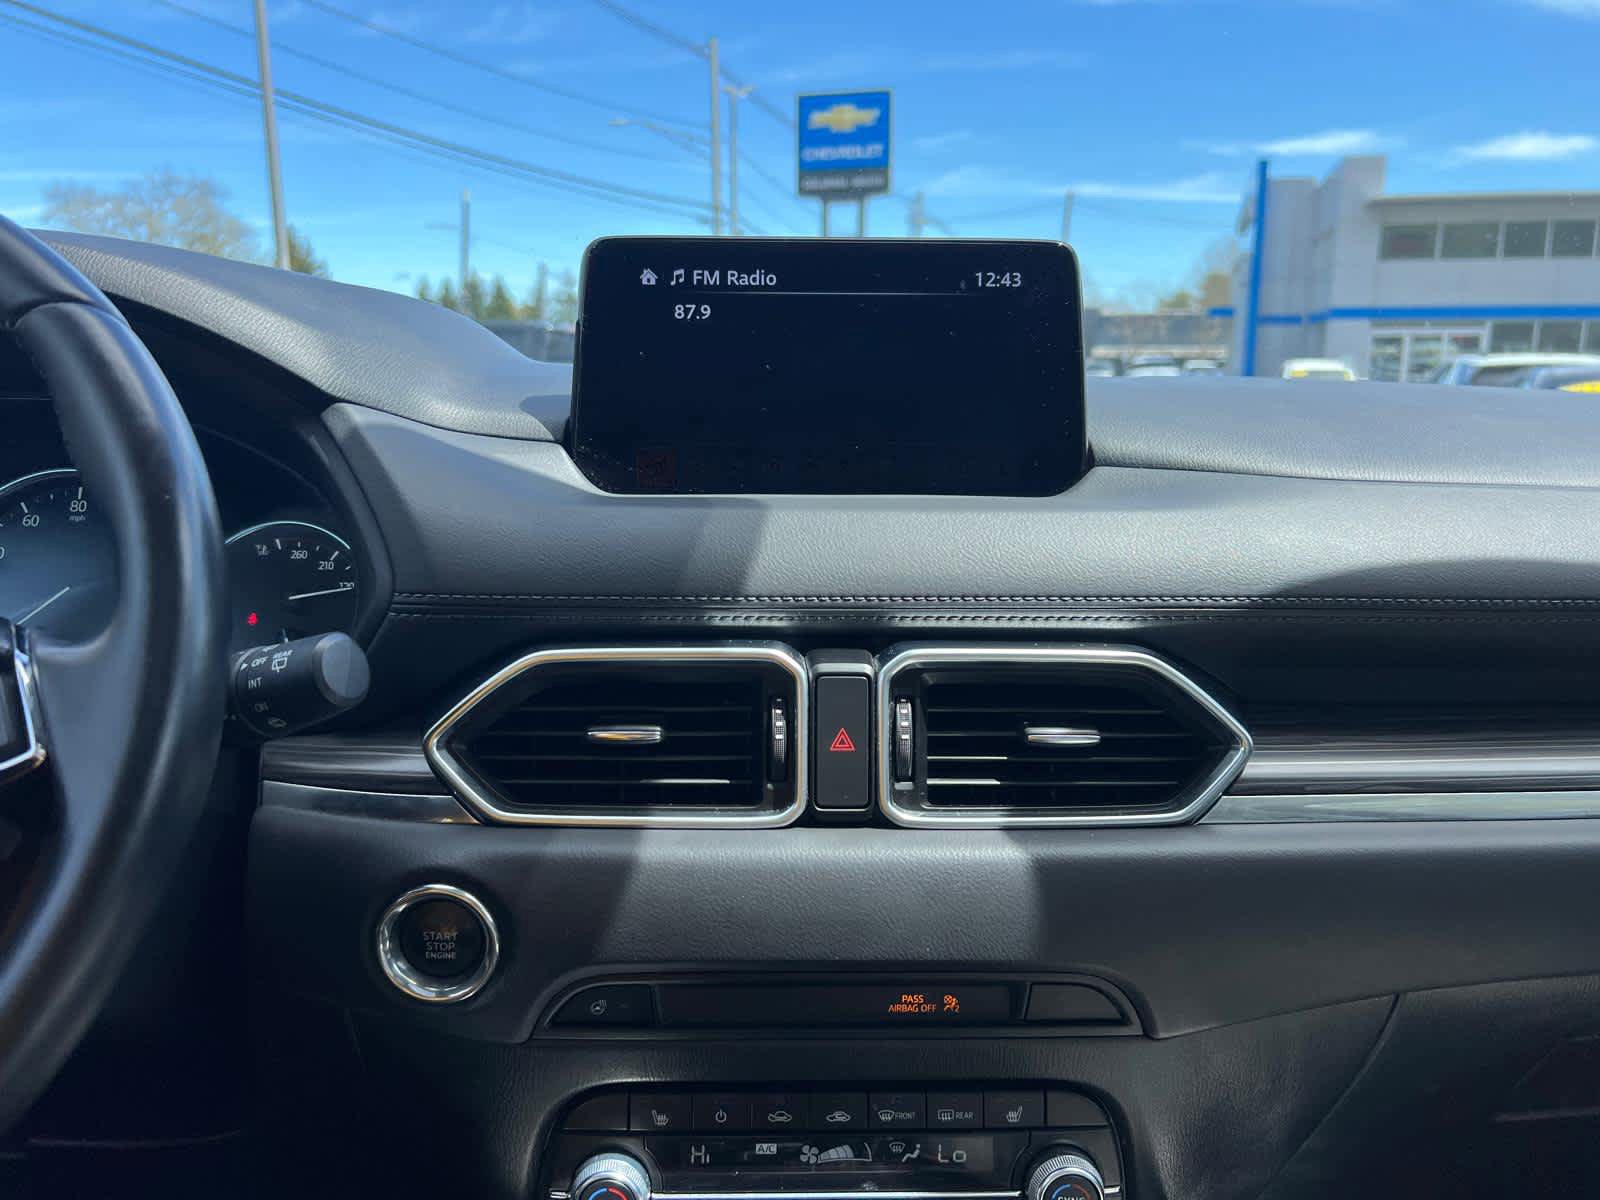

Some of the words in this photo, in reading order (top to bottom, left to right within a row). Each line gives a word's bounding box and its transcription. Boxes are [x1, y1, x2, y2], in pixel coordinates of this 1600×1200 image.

[692, 270, 720, 286] FM
[727, 270, 777, 286] Radio
[975, 272, 1022, 287] 12:43
[674, 304, 711, 320] 87.9
[70, 500, 87, 512] 80
[22, 514, 40, 527] 60
[69, 514, 85, 522] mph
[290, 550, 307, 559] 260
[318, 561, 335, 570] 210
[251, 656, 268, 667] OFF
[248, 677, 263, 689] INT
[424, 932, 457, 941] START
[426, 942, 456, 951] STOP
[426, 952, 456, 960] ENGINE
[901, 994, 925, 1003] PASS
[888, 1003, 919, 1013] AIRBAG
[920, 1003, 937, 1013] OFF
[895, 1111, 916, 1120] FRONT
[955, 1111, 973, 1120] REAR
[756, 1144, 776, 1154] A/C
[938, 1143, 967, 1163] Lo
